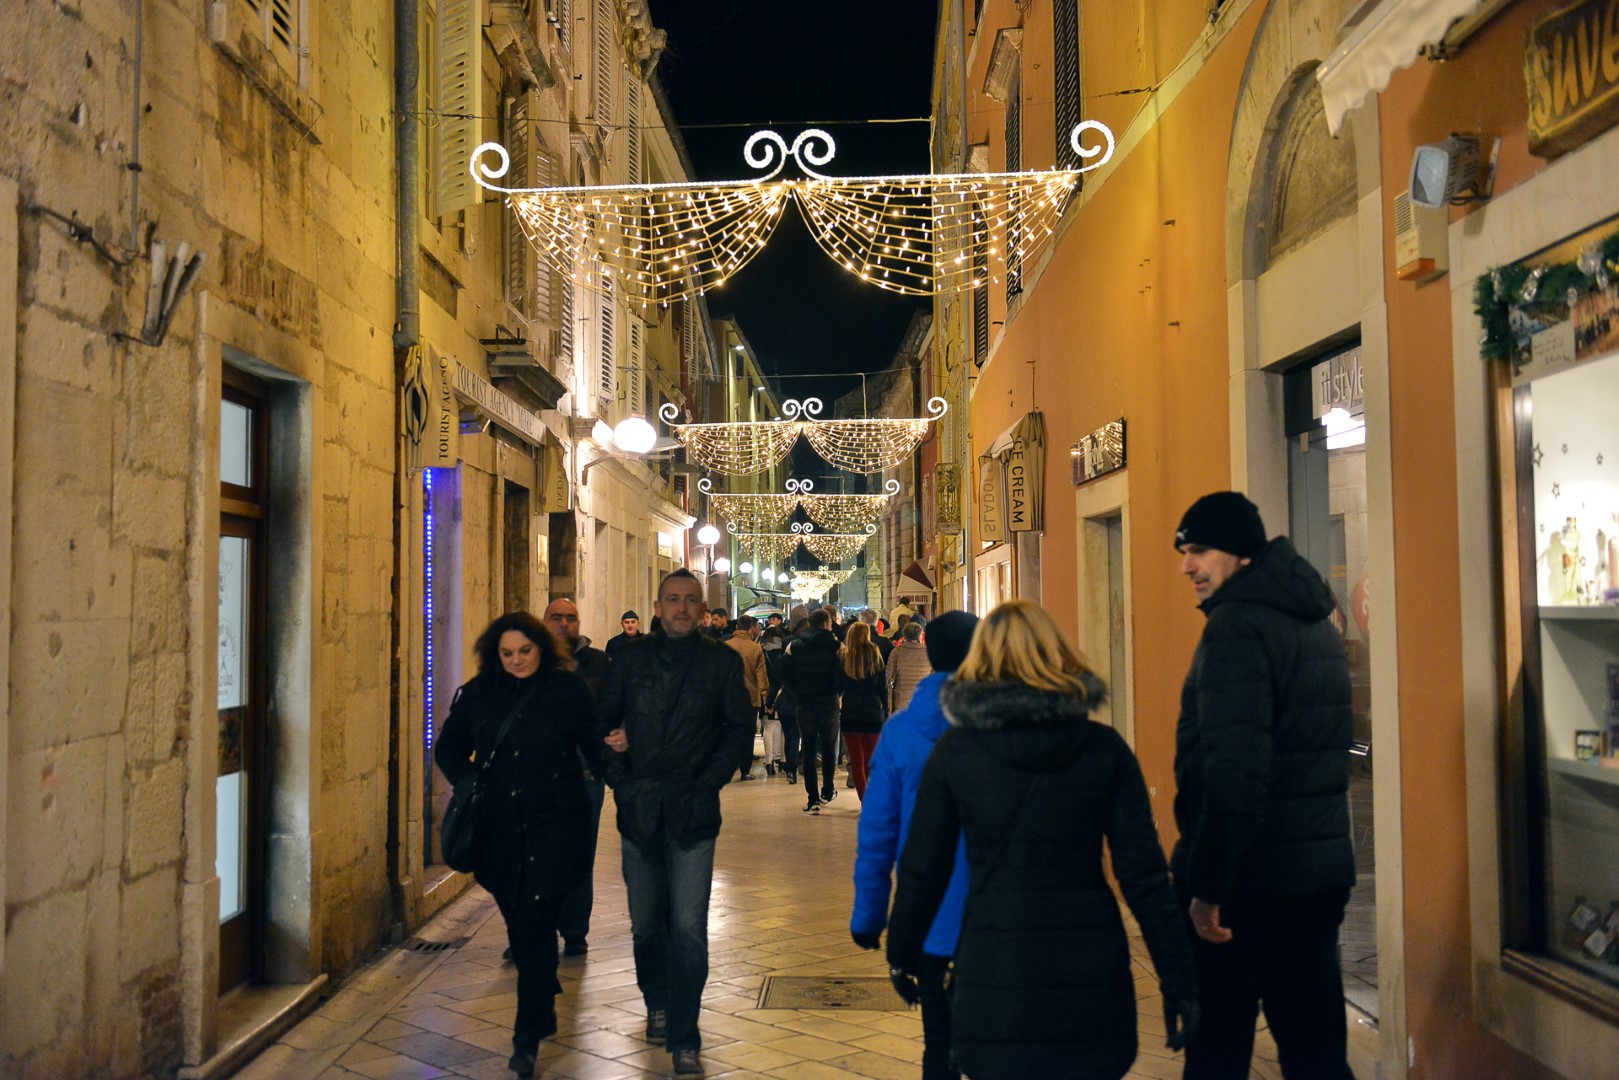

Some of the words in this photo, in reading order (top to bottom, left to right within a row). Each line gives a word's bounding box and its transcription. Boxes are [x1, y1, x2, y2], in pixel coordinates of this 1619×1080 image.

[456, 360, 487, 406] TOURIST
[488, 389, 514, 424] AGENCY
[439, 406, 451, 460] TOURIST
[1012, 466, 1024, 523] CREAM
